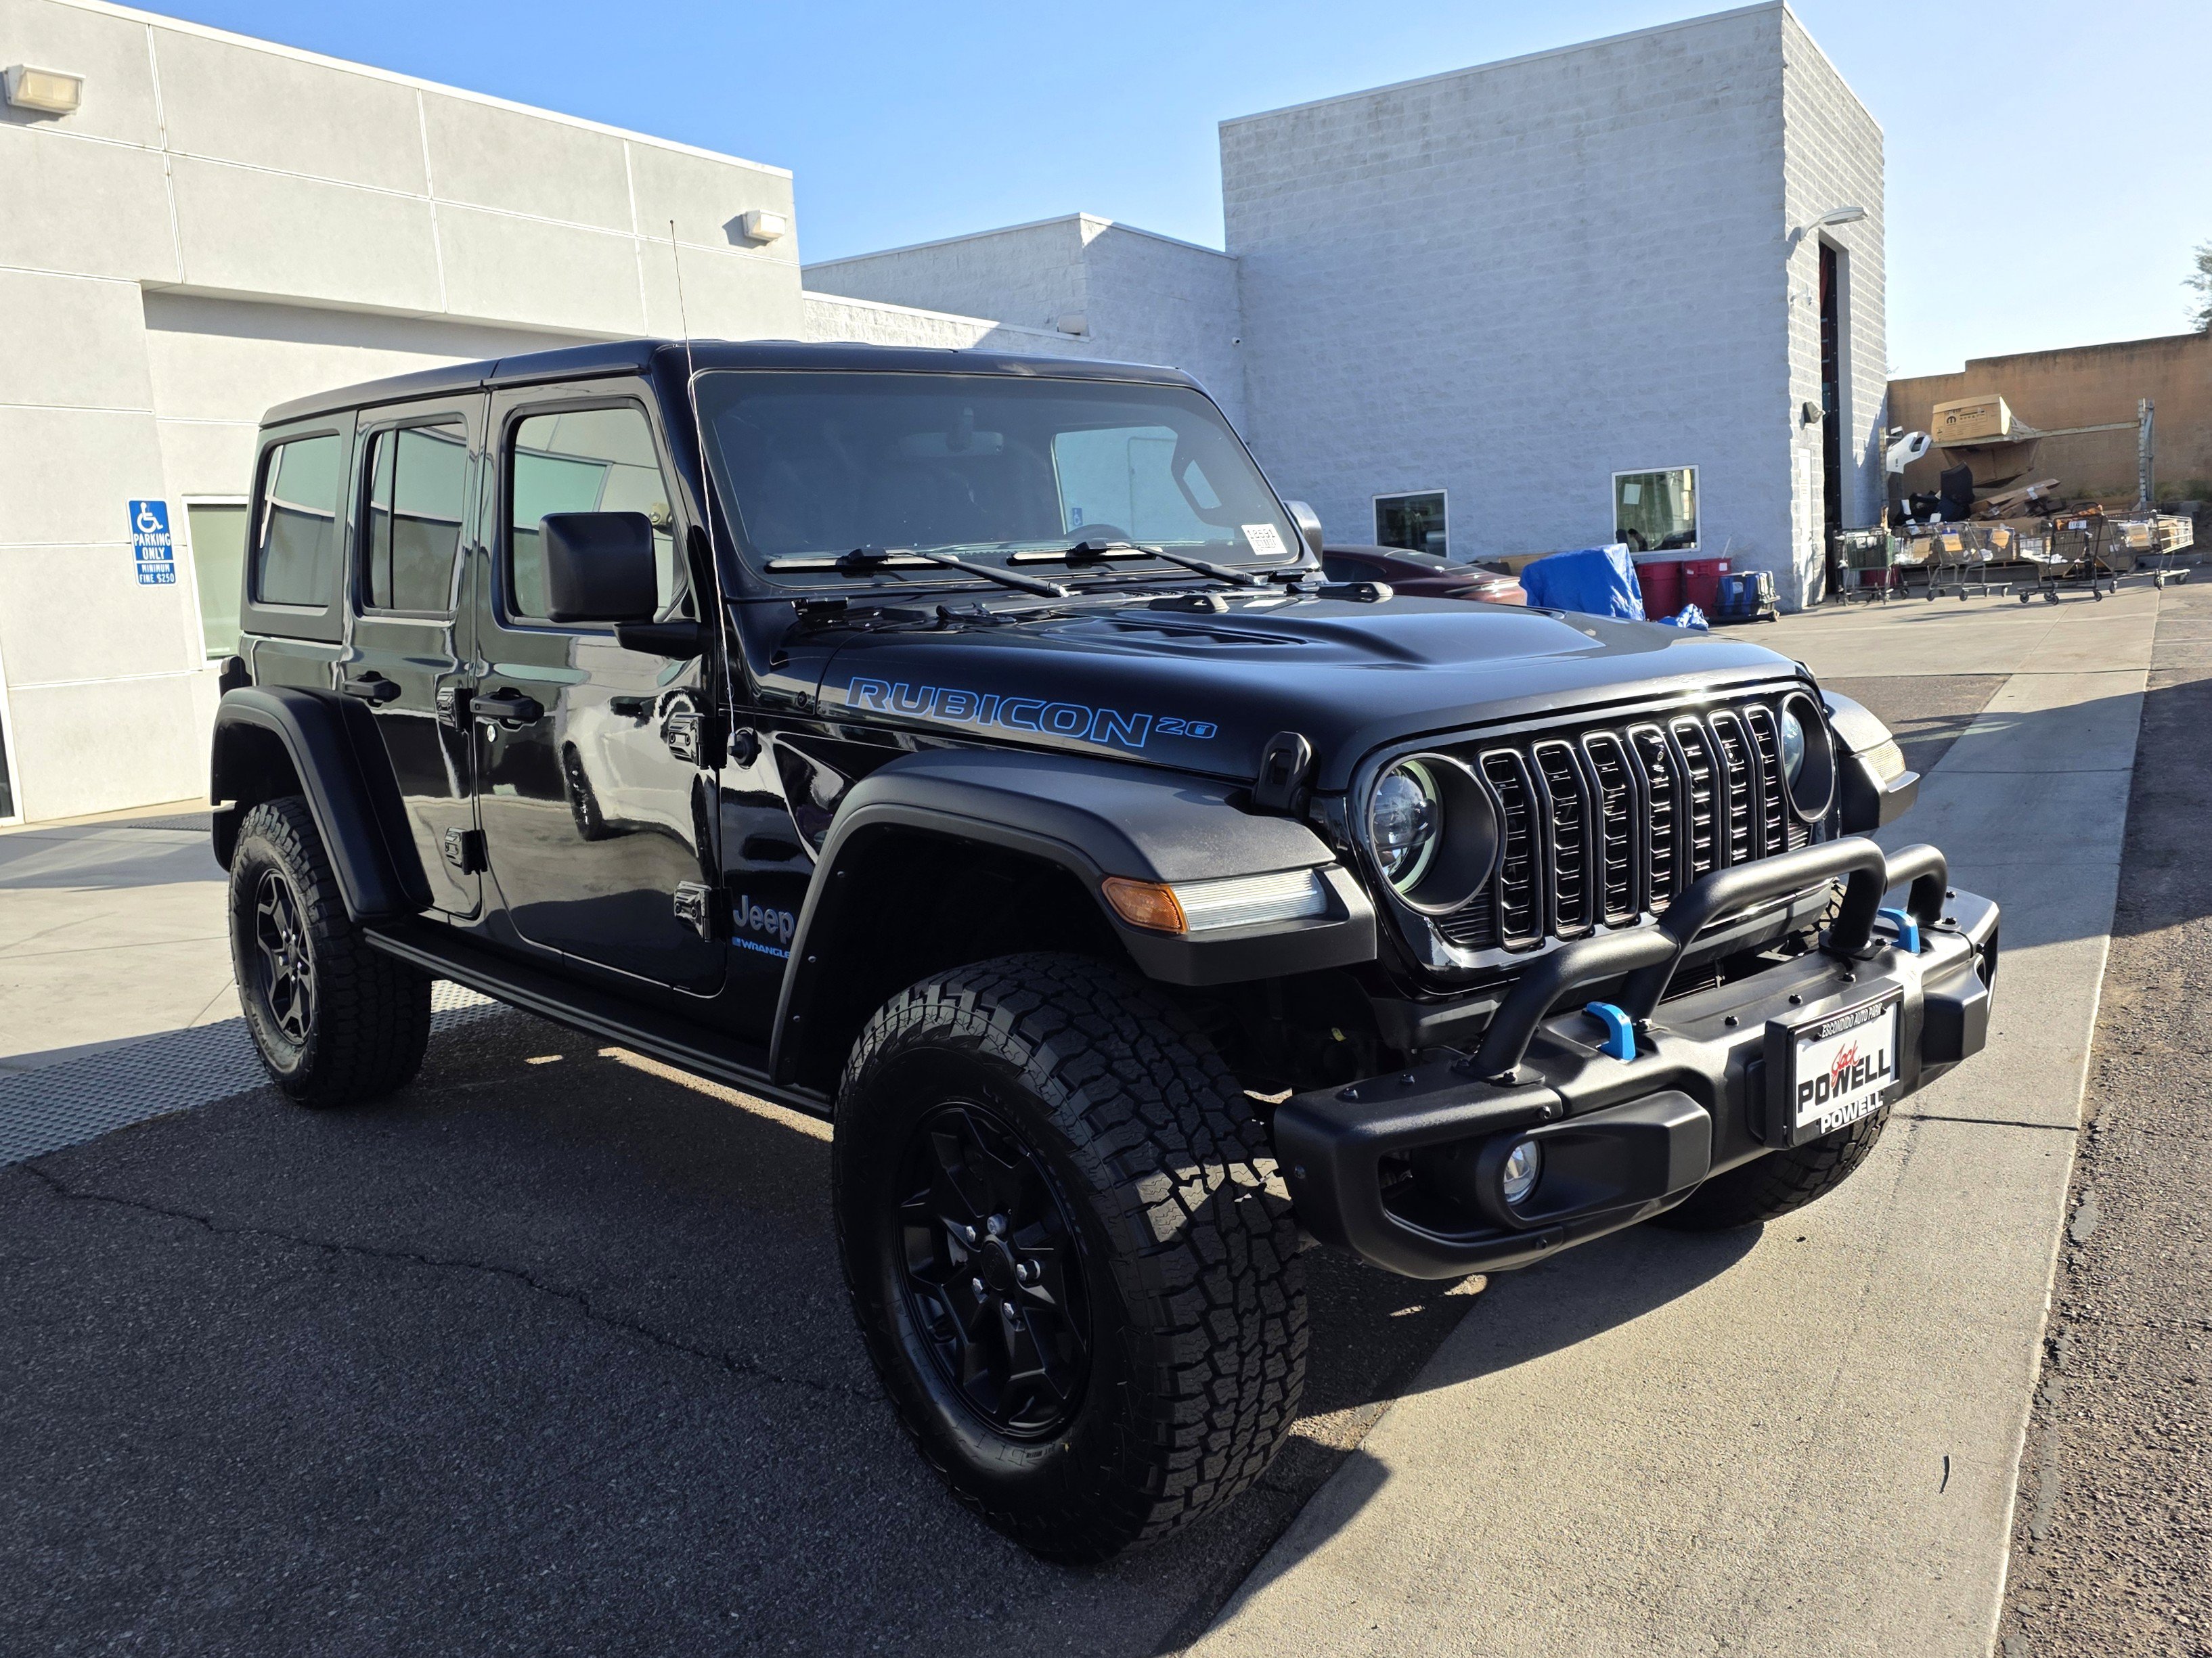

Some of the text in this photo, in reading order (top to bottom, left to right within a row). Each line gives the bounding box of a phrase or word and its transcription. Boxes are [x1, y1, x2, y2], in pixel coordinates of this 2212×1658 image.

[133, 533, 171, 546] PARKING
[143, 547, 164, 560] ONLY
[139, 573, 175, 583] FINE $250
[141, 564, 170, 573] MINIMUM
[845, 676, 1153, 748] RUBICON
[733, 895, 795, 944] Jeep
[741, 939, 791, 960] WRANGLE
[1822, 1002, 1883, 1038] ESCONDIDO AUTO PARK
[1798, 1048, 1890, 1114] POWELL
[1830, 1039, 1860, 1088] Jack
[1820, 1090, 1884, 1134] POWELL
